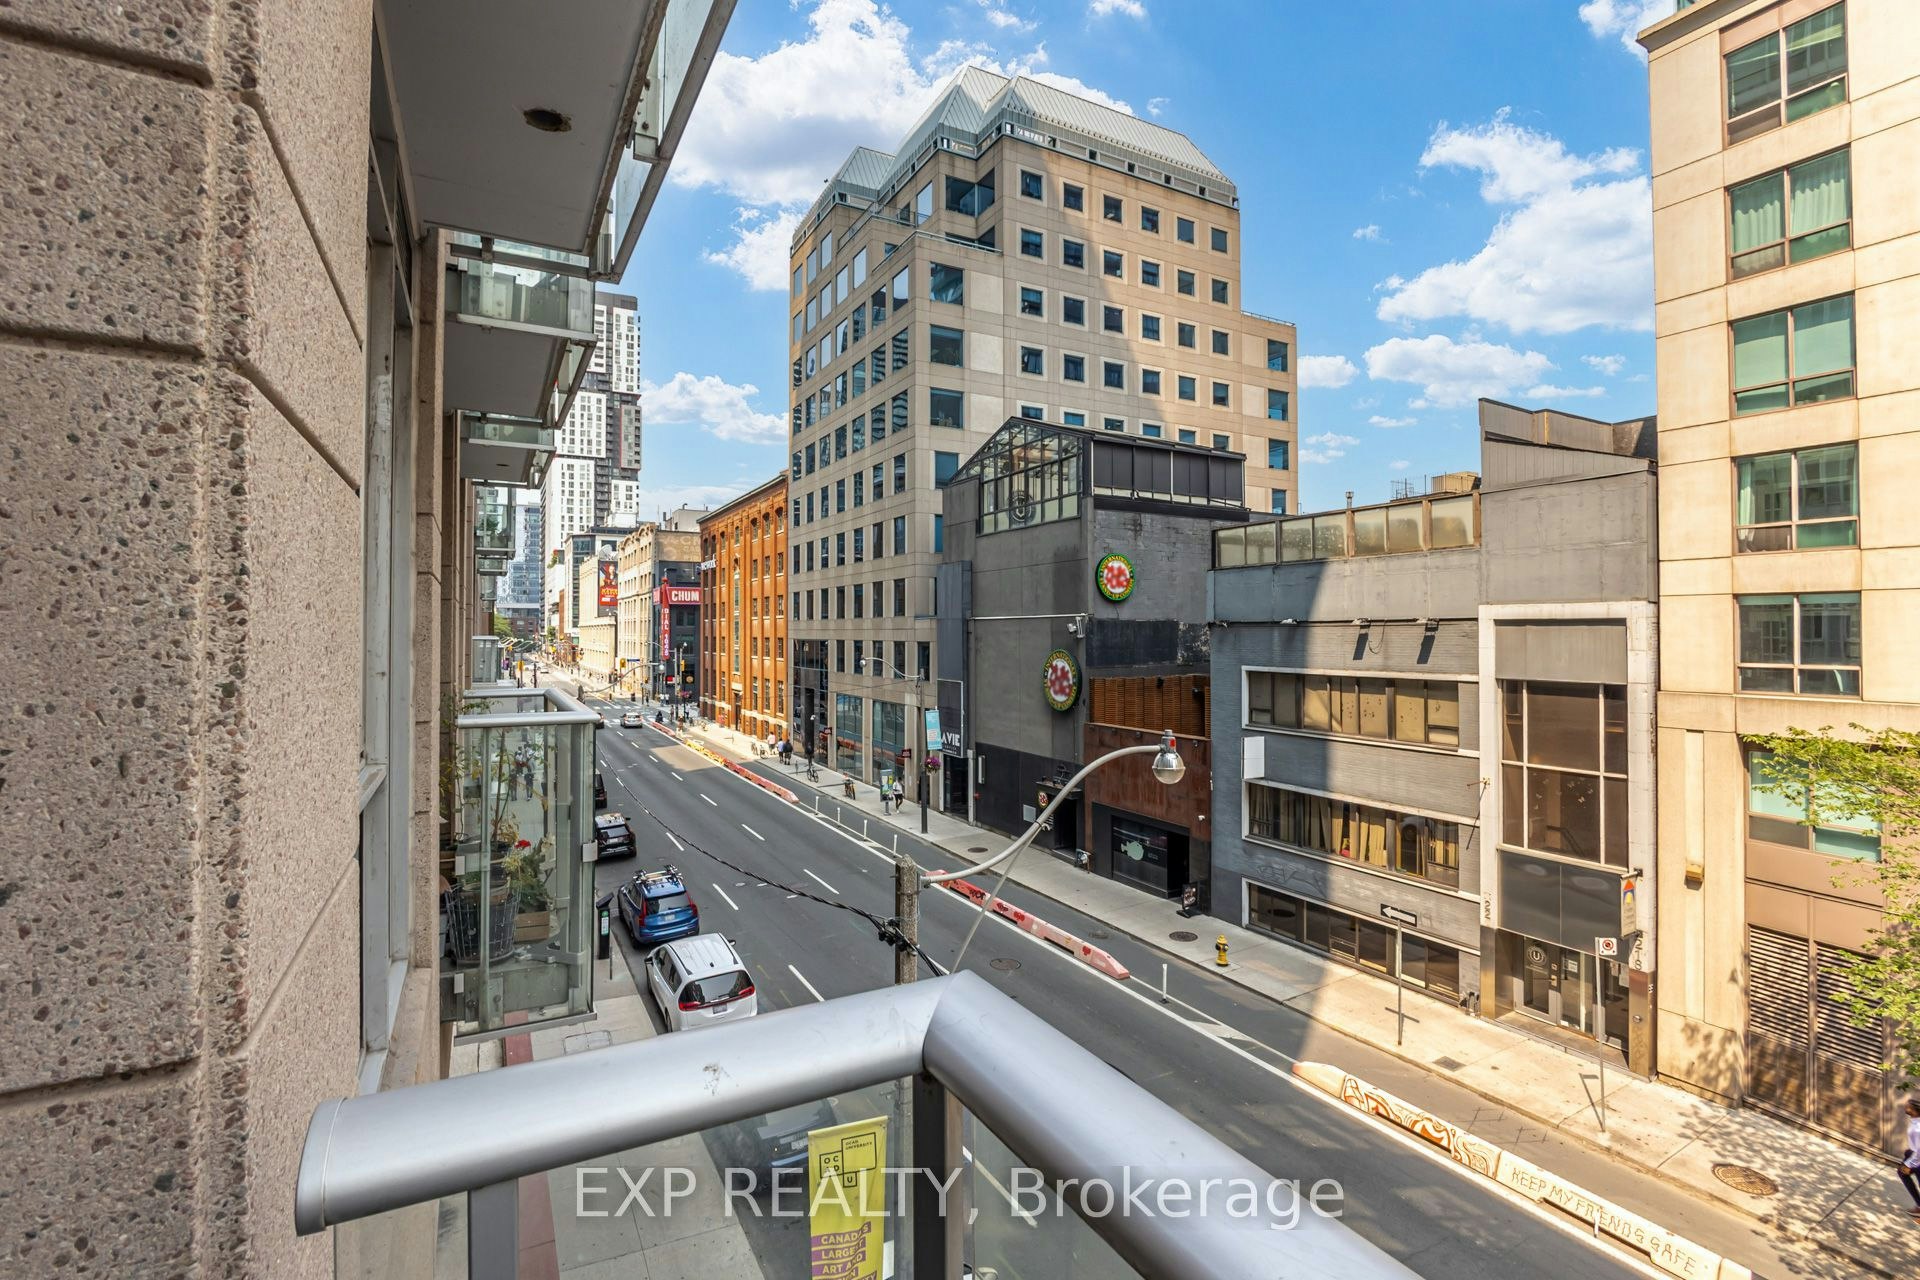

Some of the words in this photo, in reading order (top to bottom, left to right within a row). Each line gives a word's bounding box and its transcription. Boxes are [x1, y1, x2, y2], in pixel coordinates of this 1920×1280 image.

[671, 590, 700, 602] CHUM
[1511, 1167, 1547, 1193] KEEP
[1549, 1185, 1574, 1203] MY
[1575, 1199, 1645, 1244] FRENDS
[1650, 1236, 1697, 1275] SAFE
[821, 1223, 870, 1245] CANADS
[822, 1264, 842, 1274] ART
